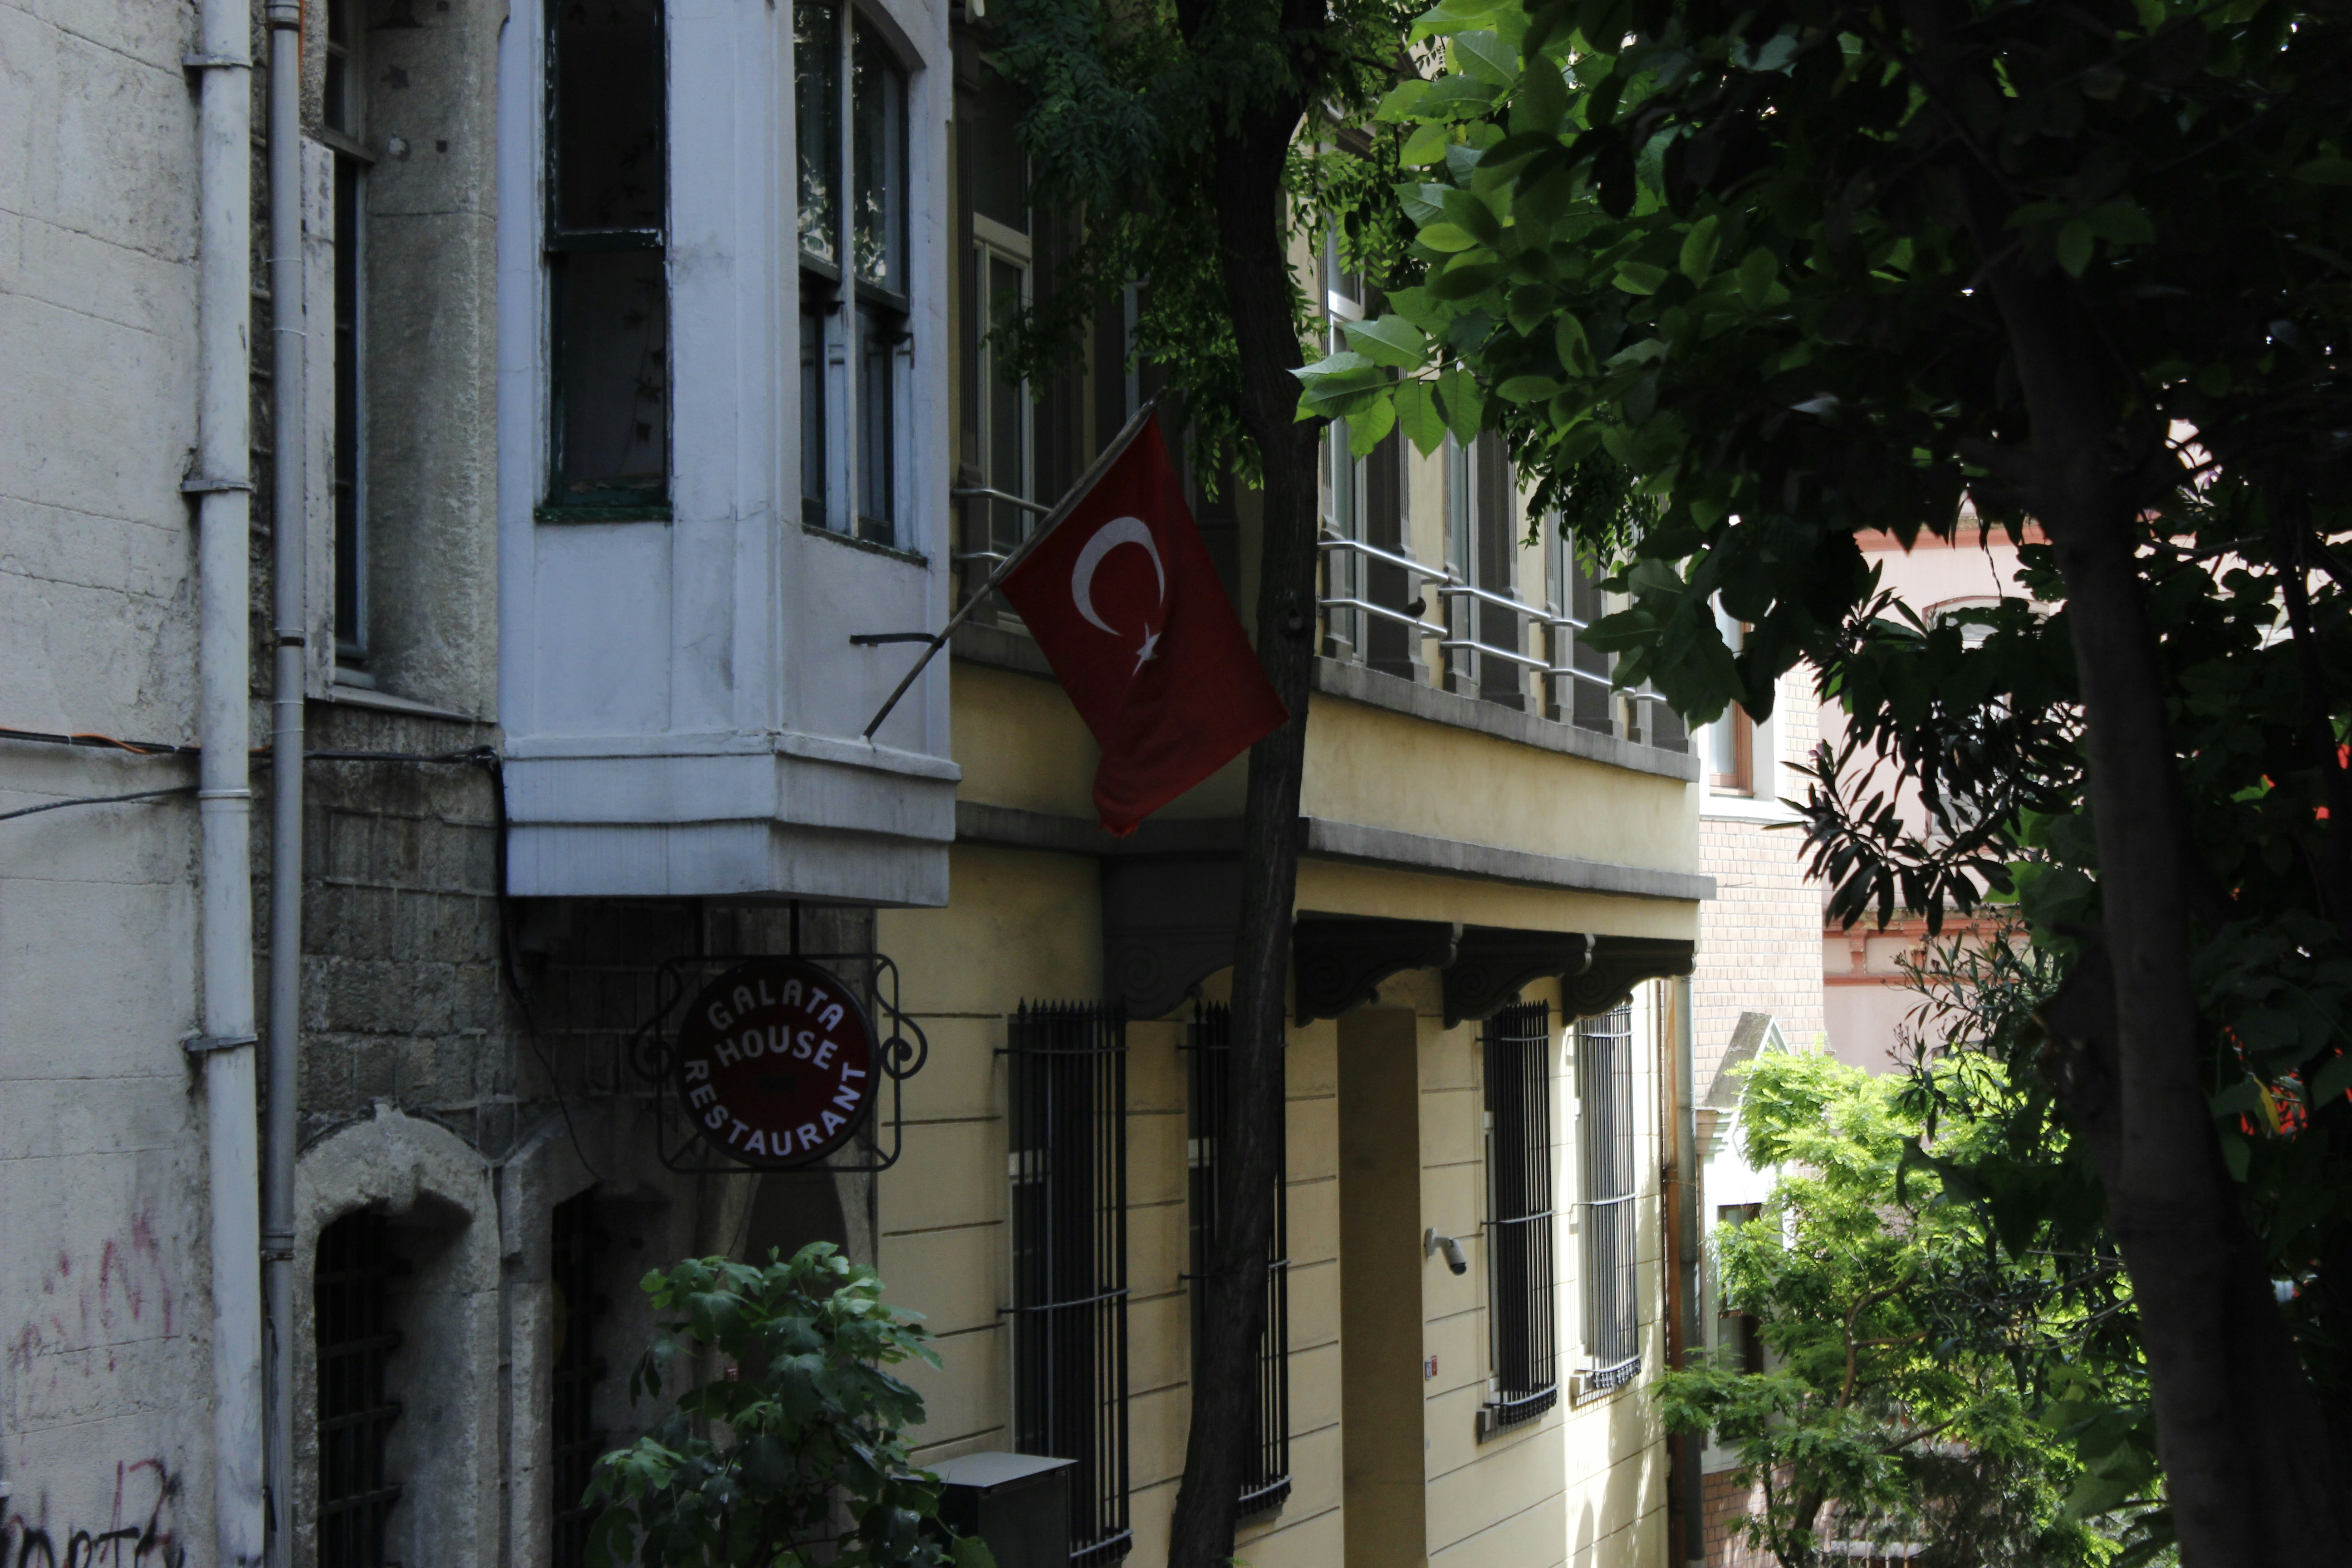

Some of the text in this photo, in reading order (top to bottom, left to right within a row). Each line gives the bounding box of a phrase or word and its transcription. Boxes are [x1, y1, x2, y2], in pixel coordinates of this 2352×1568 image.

[708, 979, 844, 1032] GALATA
[714, 1025, 838, 1070] HOUSE
[684, 1059, 866, 1156] RESTAURANT
